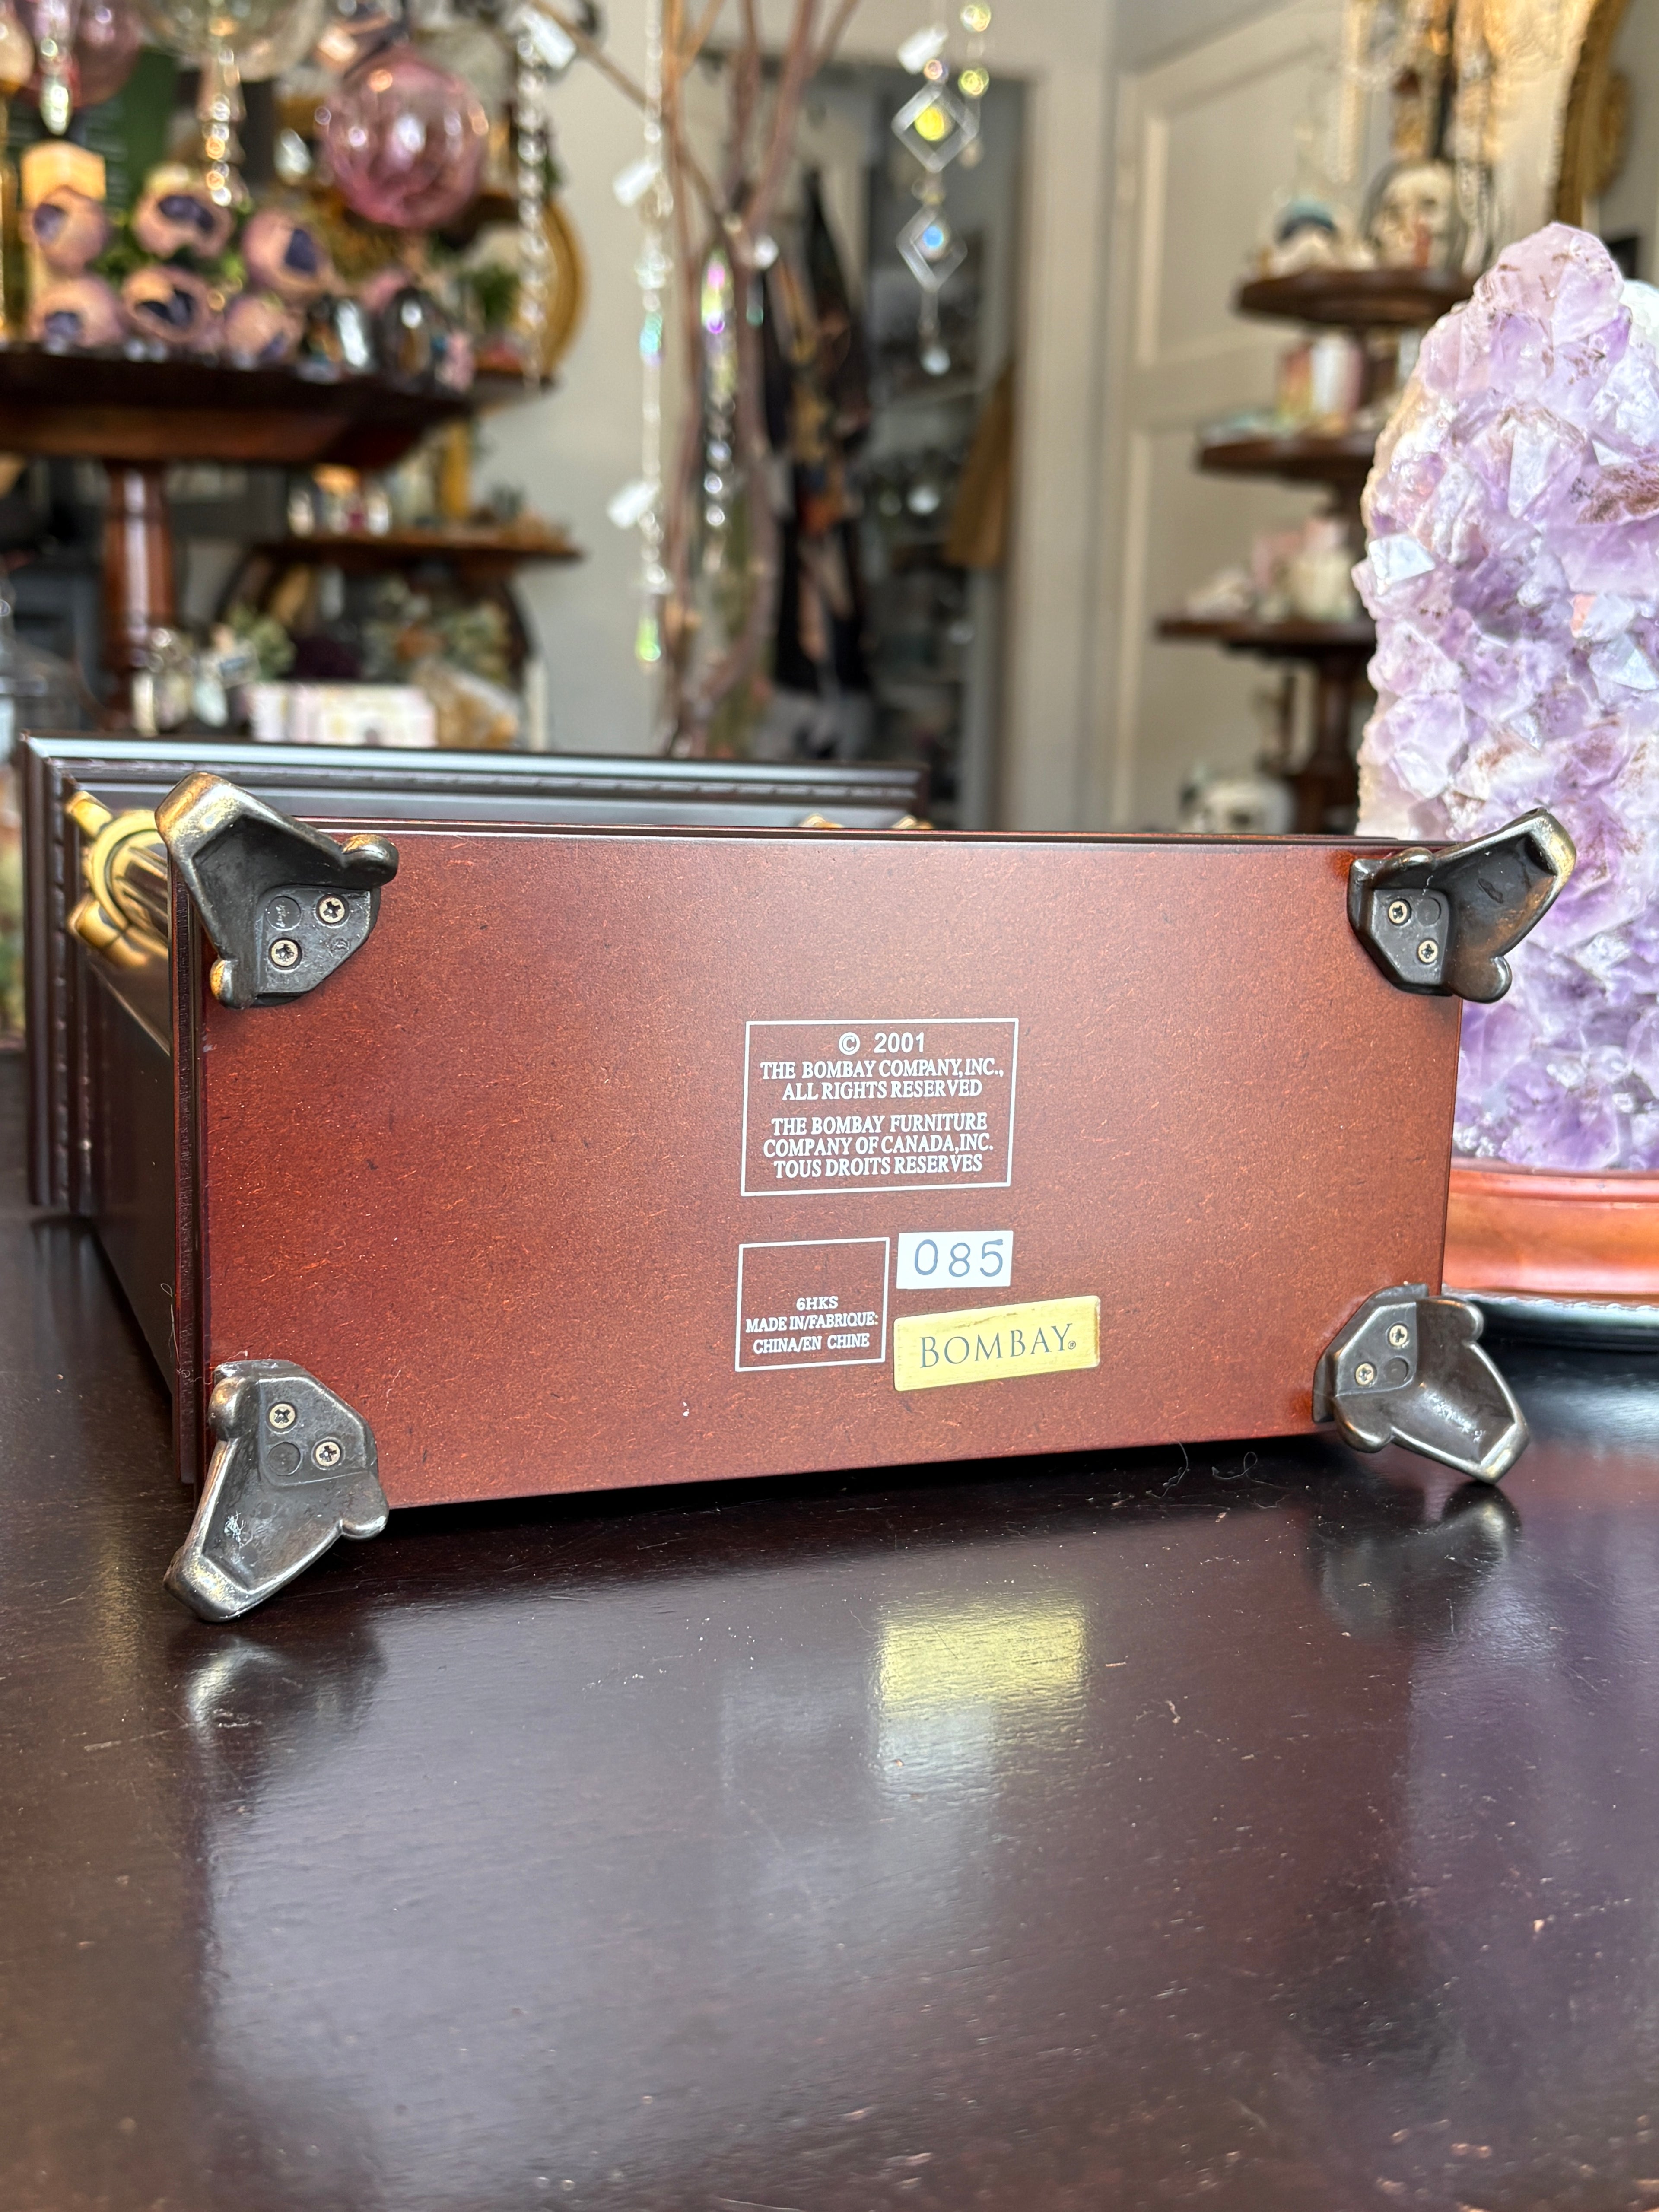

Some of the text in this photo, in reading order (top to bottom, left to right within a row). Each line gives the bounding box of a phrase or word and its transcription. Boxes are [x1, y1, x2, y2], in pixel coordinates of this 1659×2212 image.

[874, 1032, 924, 1053] 2001
[760, 1062, 796, 1079] THE
[801, 1060, 877, 1079] BOMBAY
[782, 1079, 982, 1100] ALL RIGHTS RESERVED
[771, 1112, 988, 1136] THE BOMBAY FURNITURE
[763, 1138, 853, 1158] COMPANY
[855, 1137, 878, 1154] OF
[773, 1154, 982, 1179] TOUS DROITS RESERVES
[914, 1239, 1004, 1278] 085
[796, 1296, 838, 1312] 6HKS
[746, 1316, 787, 1333] MADE
[753, 1333, 870, 1354] CHINA/EN CHINE
